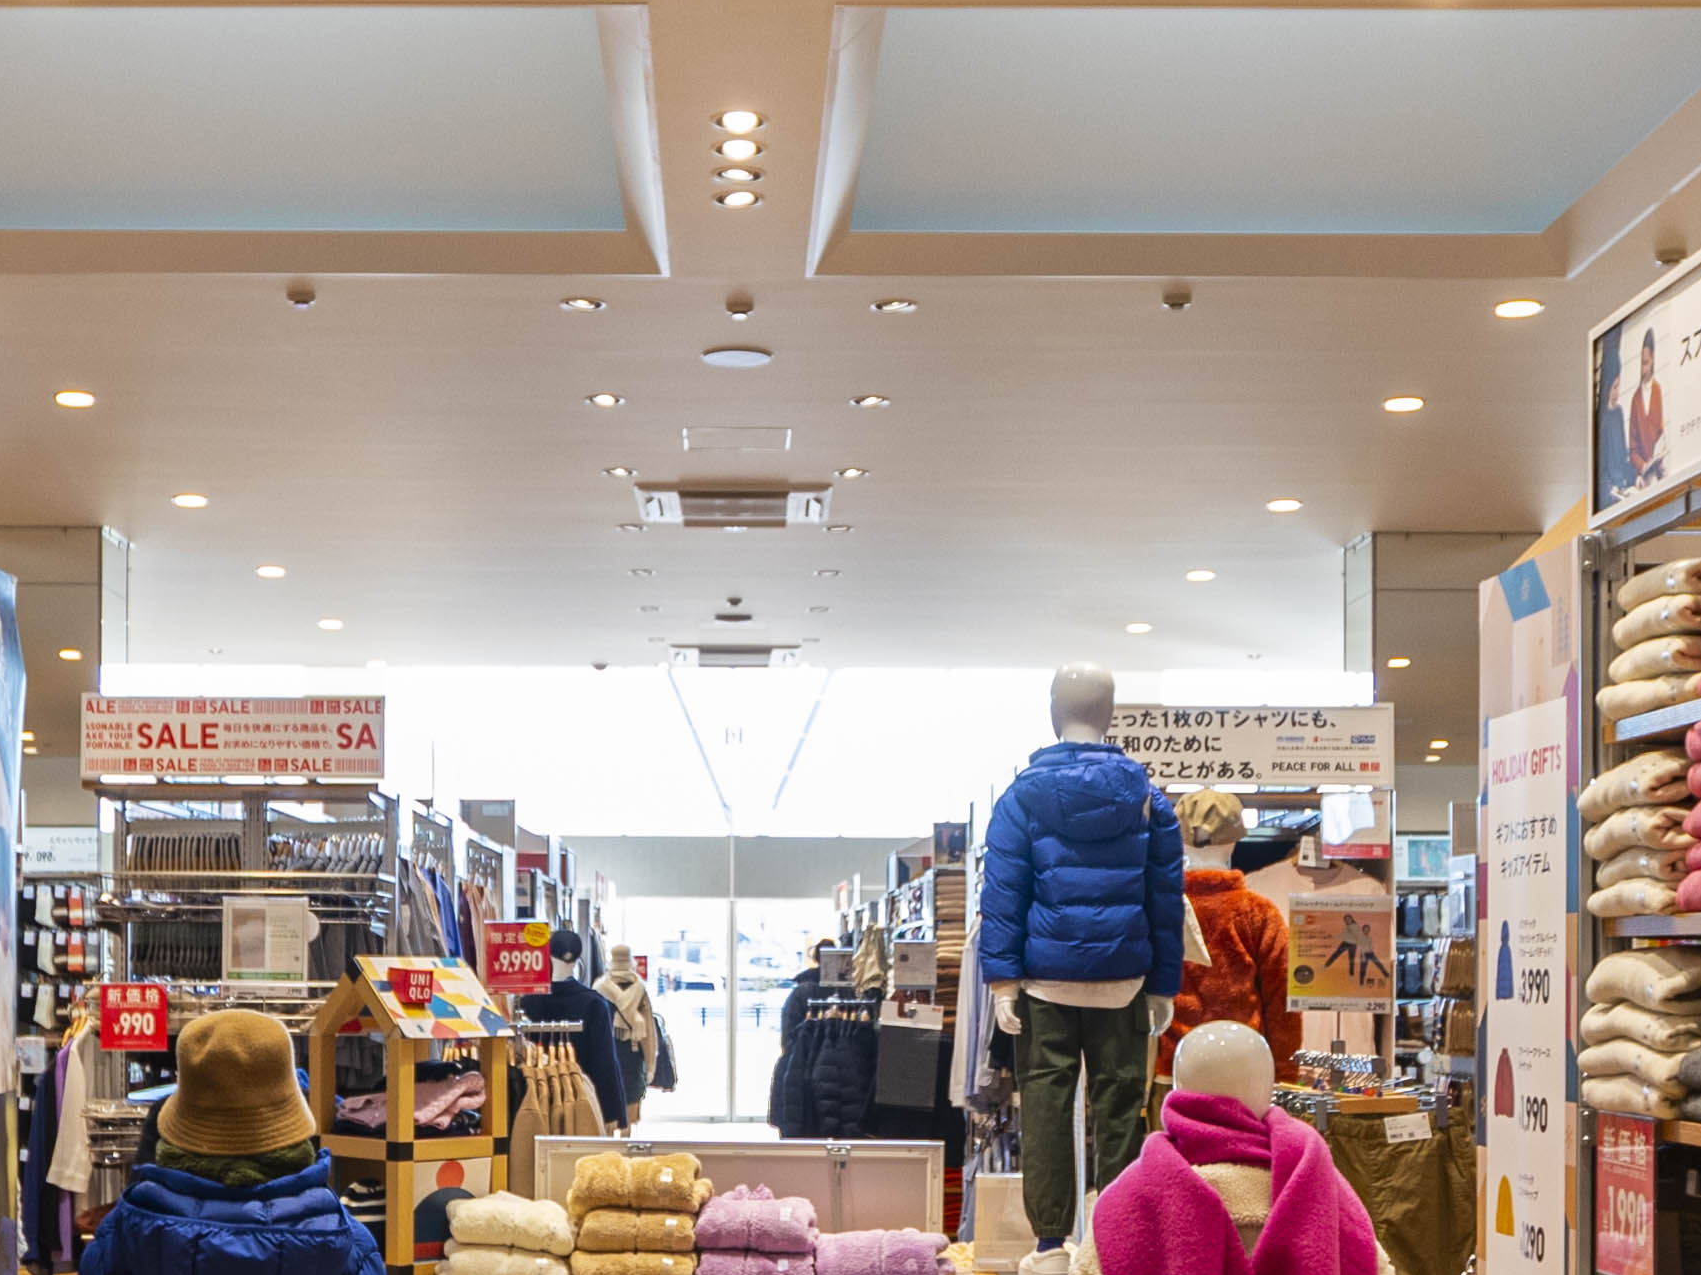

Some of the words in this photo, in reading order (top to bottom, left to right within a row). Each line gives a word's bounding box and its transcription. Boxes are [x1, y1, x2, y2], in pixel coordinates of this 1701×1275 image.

[209, 700, 249, 714] SALE
[137, 723, 219, 749] SALE
[336, 722, 377, 750] SA
[1103, 735, 1222, 753] 平和のために
[156, 758, 197, 772] SALE
[291, 758, 332, 772] SALE
[1272, 762, 1306, 772] PEACE
[1311, 762, 1330, 772] FOR
[1335, 762, 1356, 772] ALL
[1492, 750, 1528, 786] HOLIDAY
[1531, 744, 1562, 775] GIFTS
[1496, 814, 1557, 844] ギフトにおすすめ
[1501, 852, 1552, 878] キッズアイテム
[493, 951, 543, 972] ¥9,990
[410, 973, 430, 986] UNI
[107, 988, 159, 1004] 新価格
[409, 987, 430, 1000] QLO
[112, 1012, 155, 1036] ¥990
